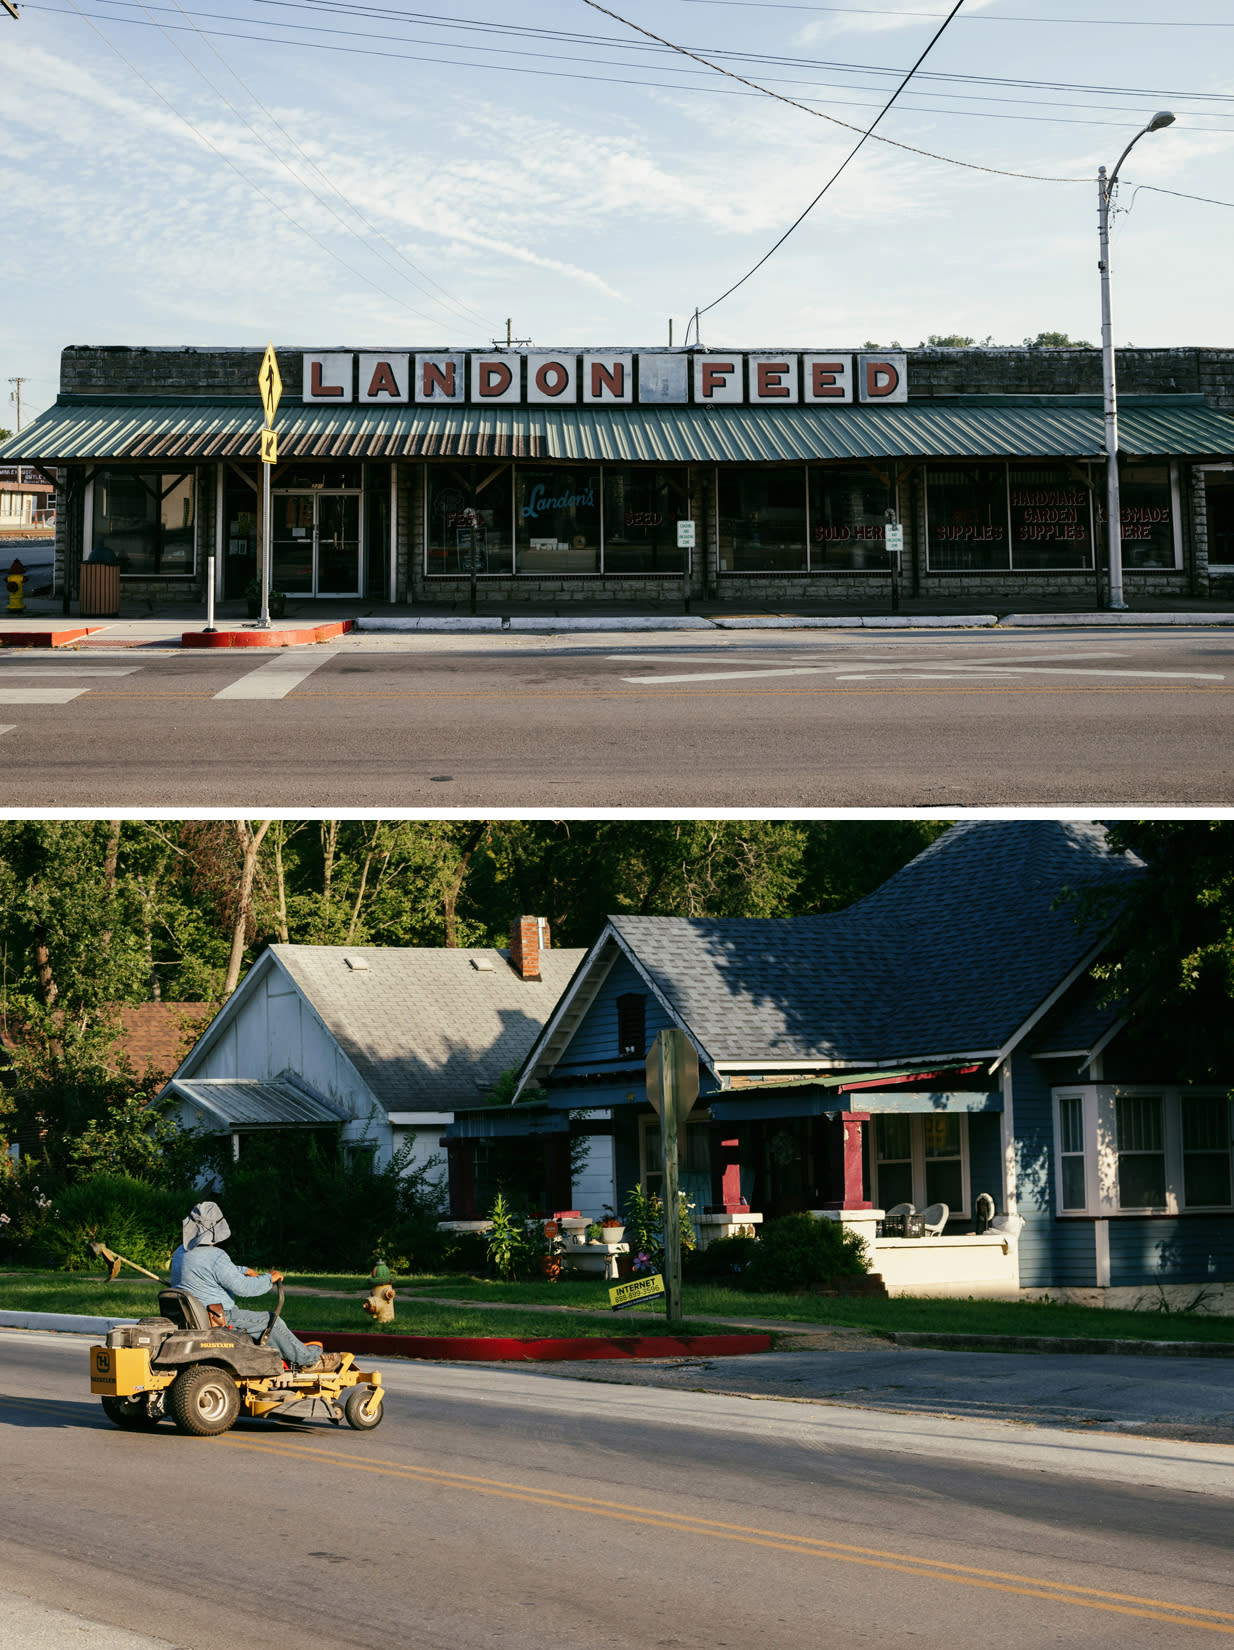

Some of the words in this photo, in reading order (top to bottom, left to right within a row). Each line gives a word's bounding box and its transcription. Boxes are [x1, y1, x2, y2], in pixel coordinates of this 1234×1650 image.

[311, 361, 624, 398] LANDON
[702, 362, 899, 398] FEED
[521, 482, 596, 518] Landon's
[1010, 490, 1087, 506] HARDWARE
[624, 511, 662, 527] SEED
[1024, 507, 1078, 523] GARDEN
[1132, 506, 1169, 523] MADE
[814, 525, 850, 541] SOLD
[936, 525, 1003, 541] SUPPLIES
[1018, 525, 1085, 541] SUPPLIES
[616, 1277, 656, 1296] INTERNET
